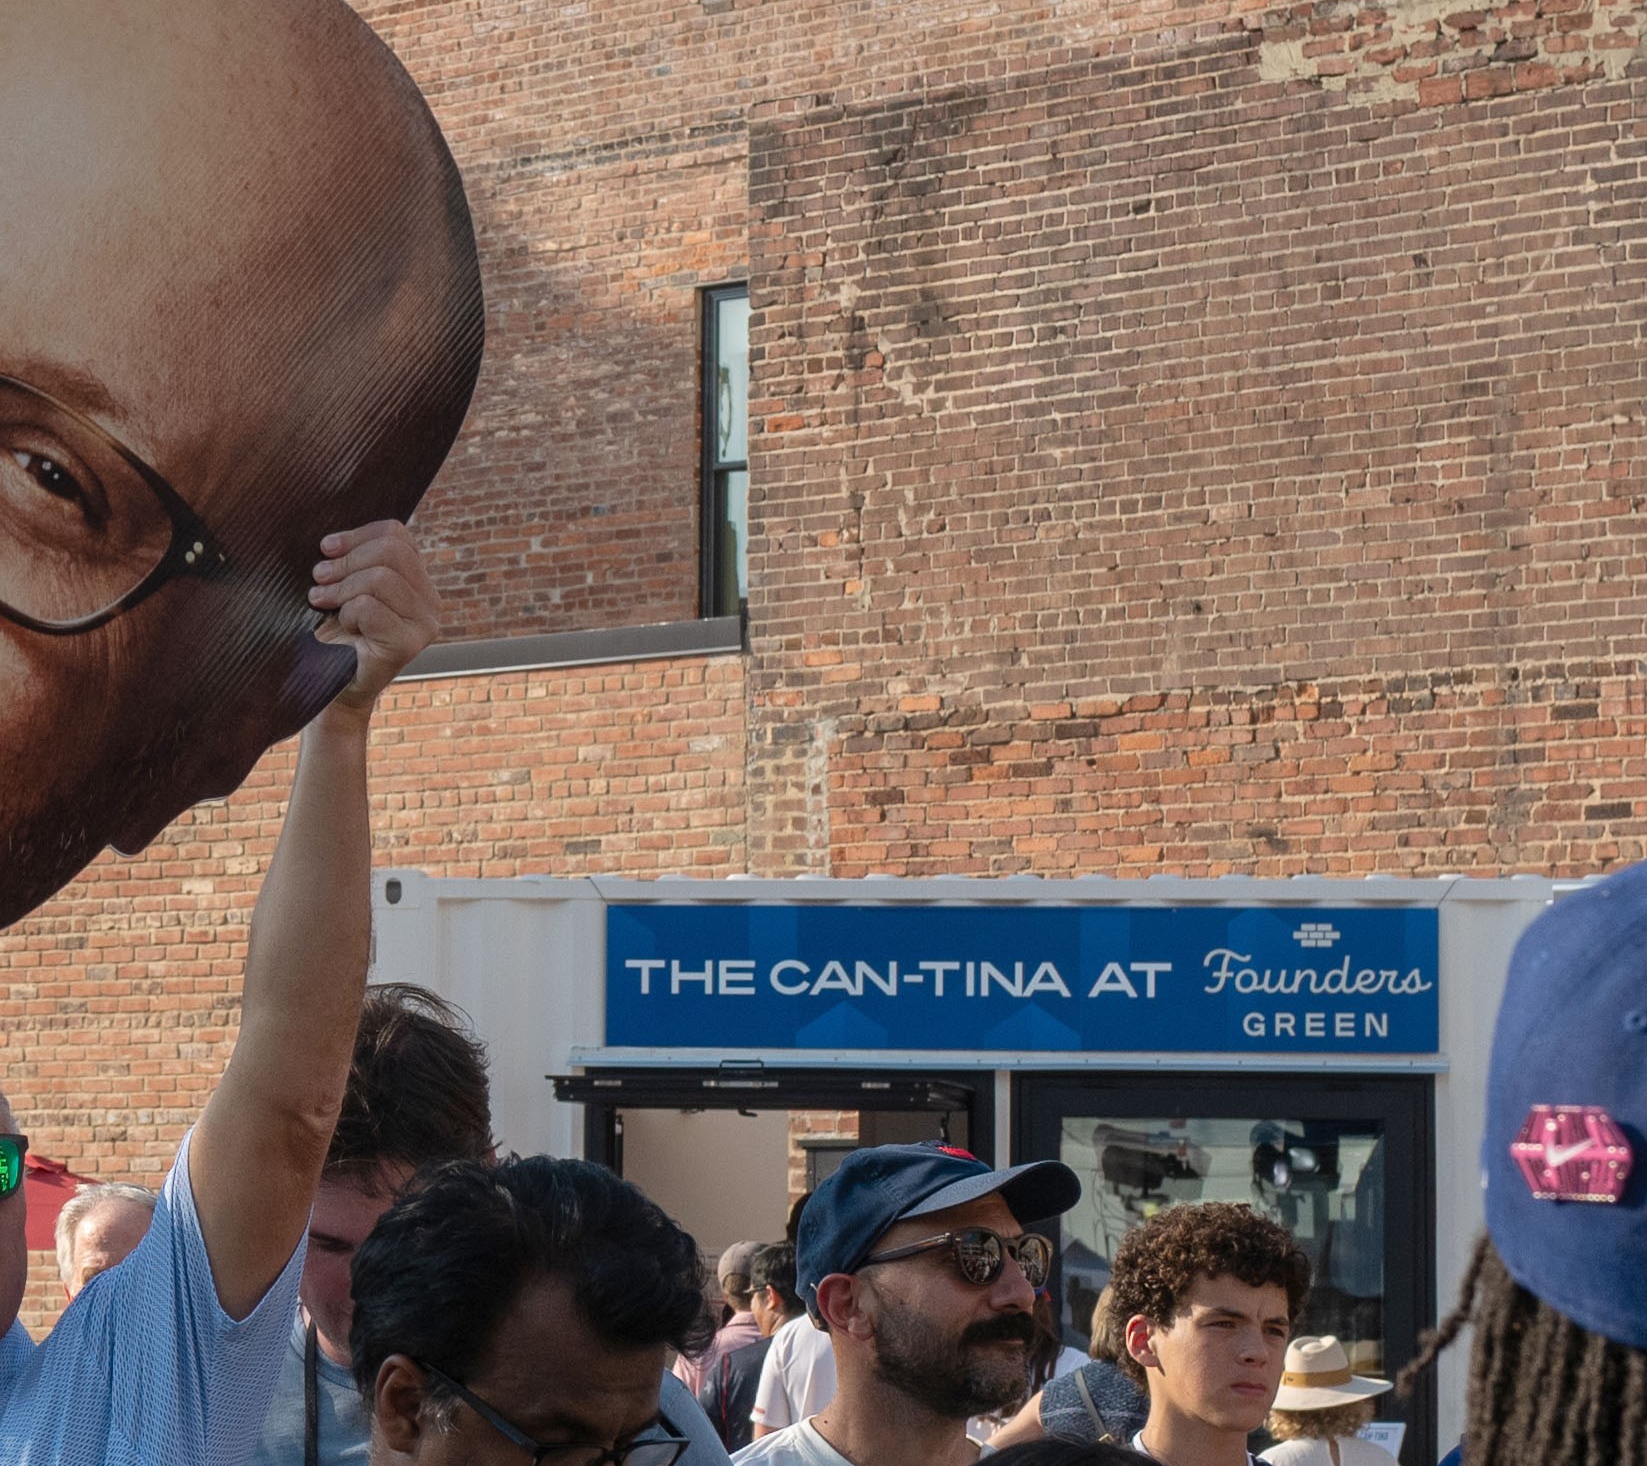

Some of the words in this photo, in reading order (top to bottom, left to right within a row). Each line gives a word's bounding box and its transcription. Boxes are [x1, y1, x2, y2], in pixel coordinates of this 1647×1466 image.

[625, 960, 756, 995] THE
[769, 960, 1071, 997] CAN-TINA
[1088, 962, 1173, 997] AT
[1202, 949, 1432, 996] Founders
[1243, 1012, 1390, 1037] GREEN
